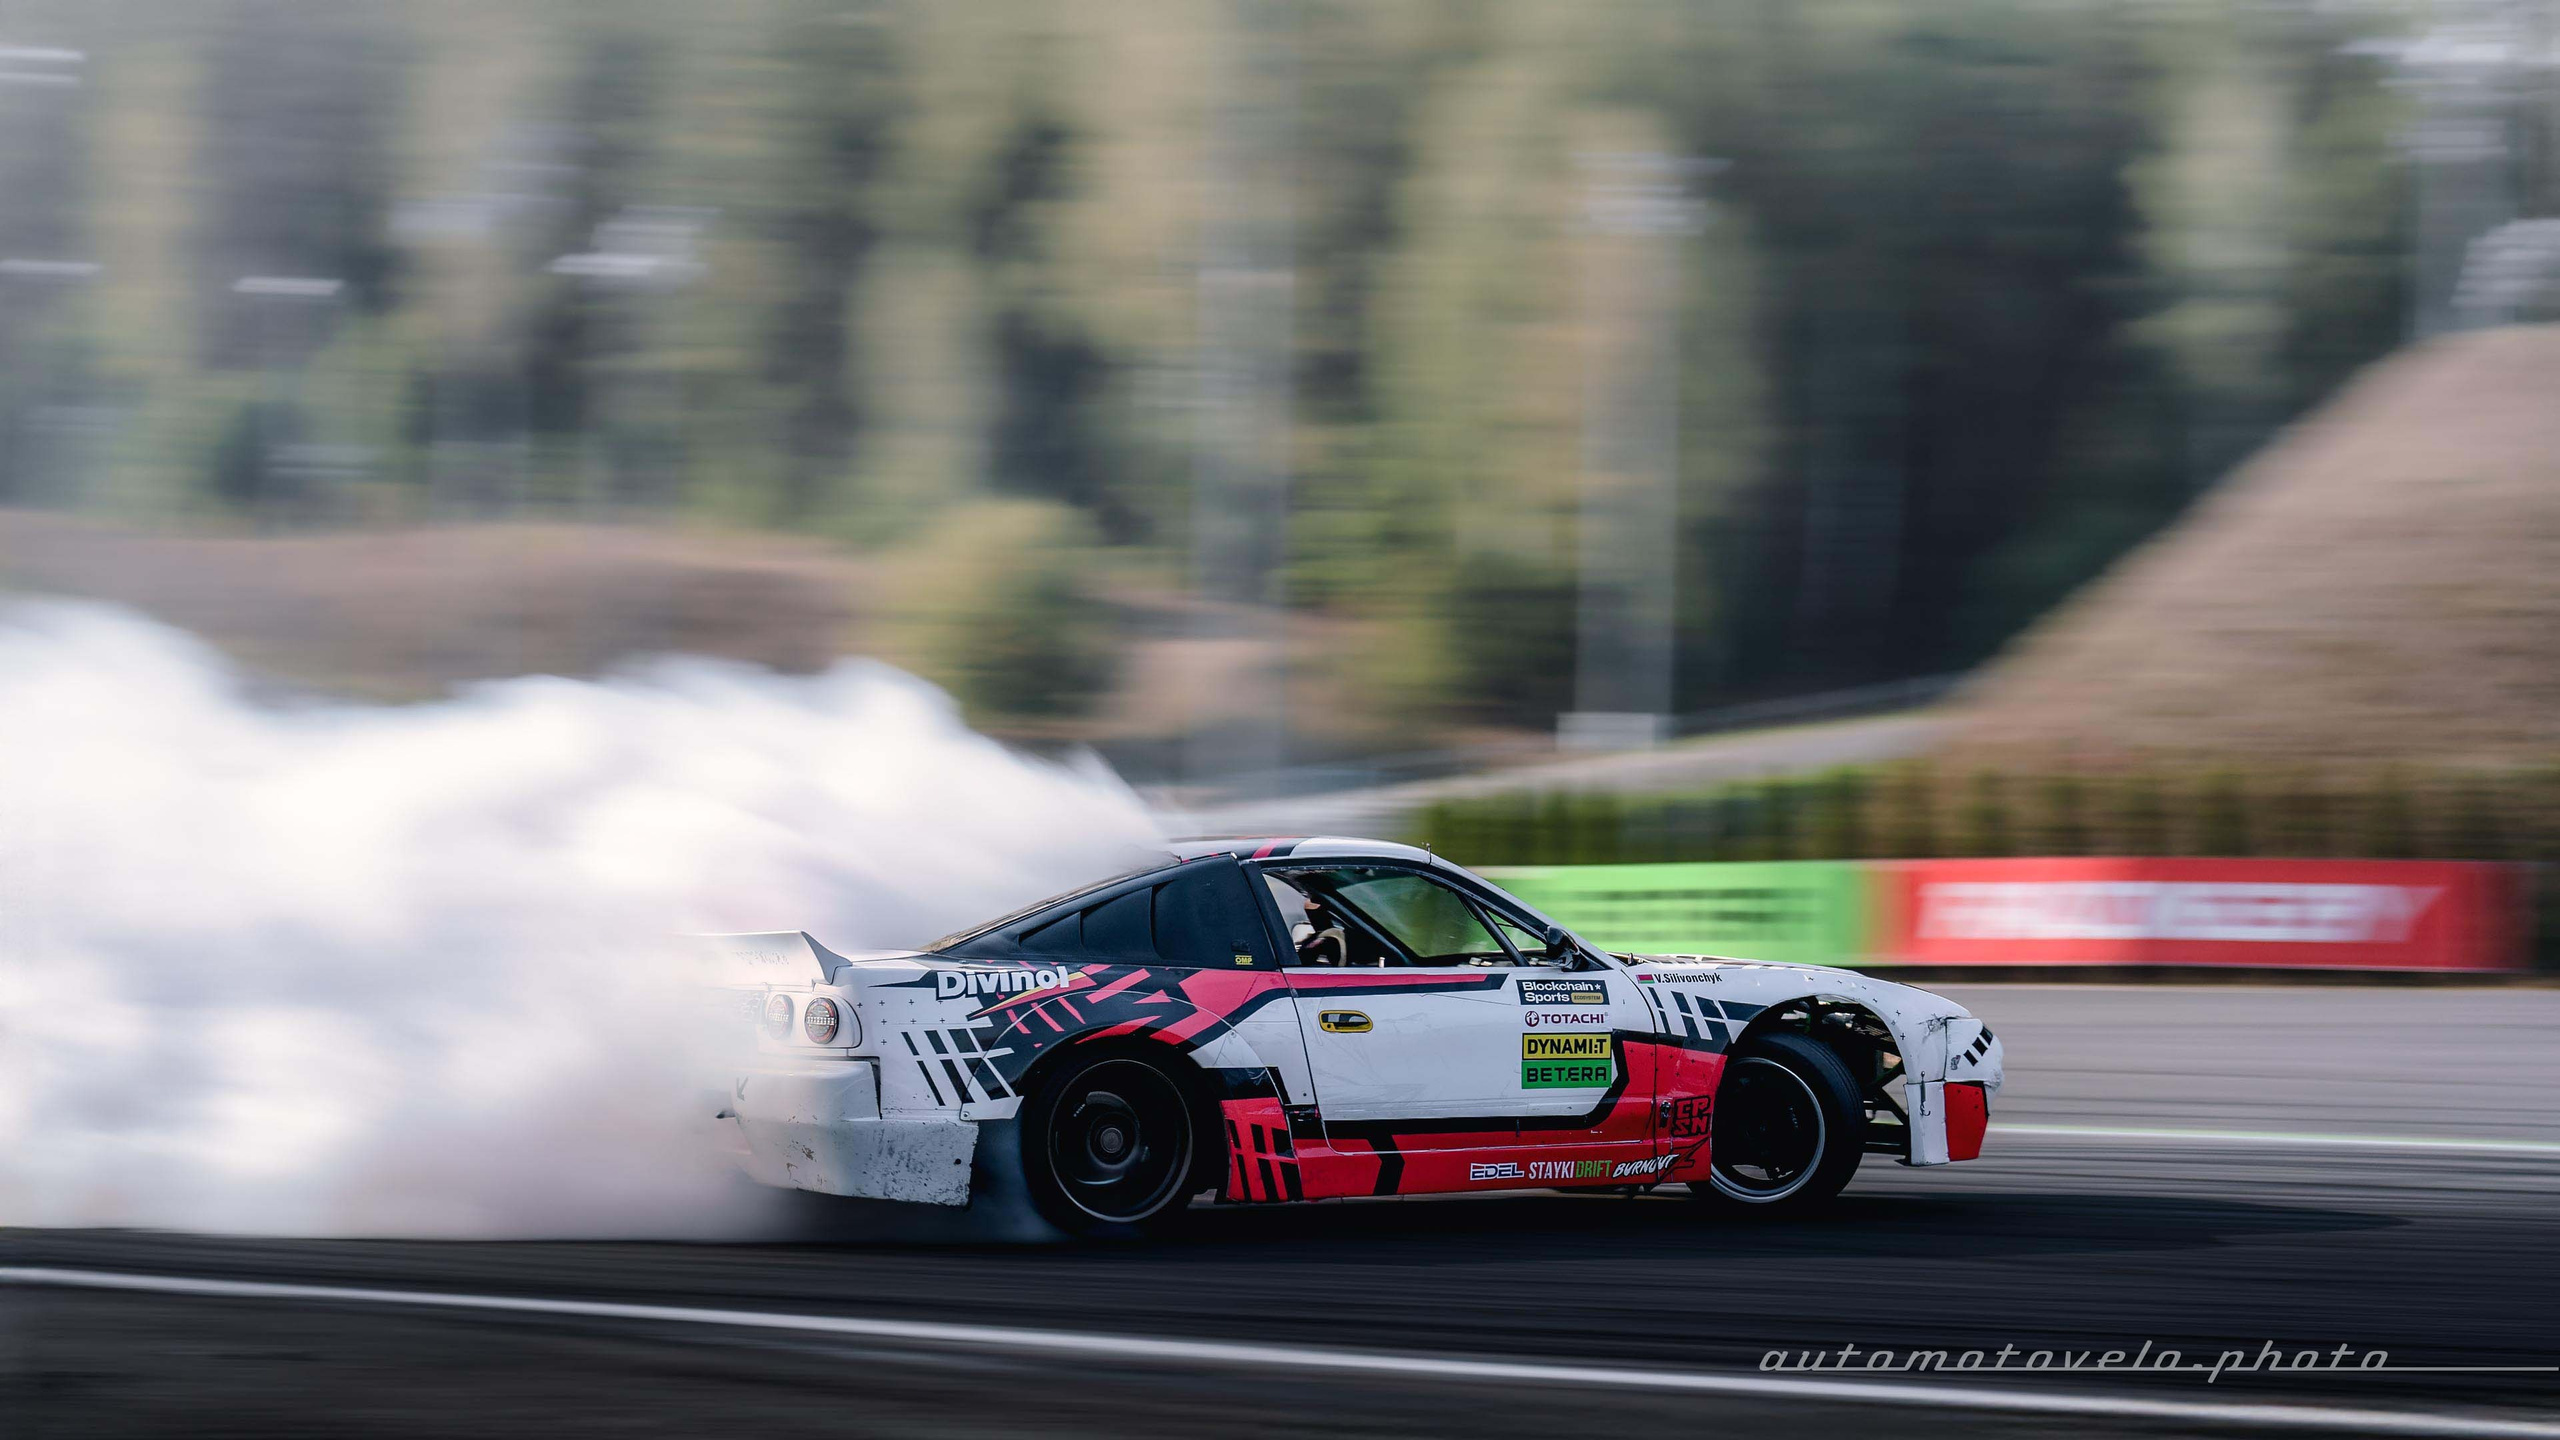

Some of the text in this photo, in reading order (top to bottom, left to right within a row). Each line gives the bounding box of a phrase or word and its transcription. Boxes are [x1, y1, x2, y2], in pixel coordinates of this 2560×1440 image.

[1234, 955, 1254, 965] OMP
[936, 966, 1070, 998] Divinol
[1653, 972, 1723, 984] V.Silivonchyk
[1522, 981, 1594, 991] Blockchain
[1524, 992, 1570, 1004] Sports
[1541, 1013, 1605, 1024] TOTACHI
[1612, 1154, 1680, 1178] BURNOUT
